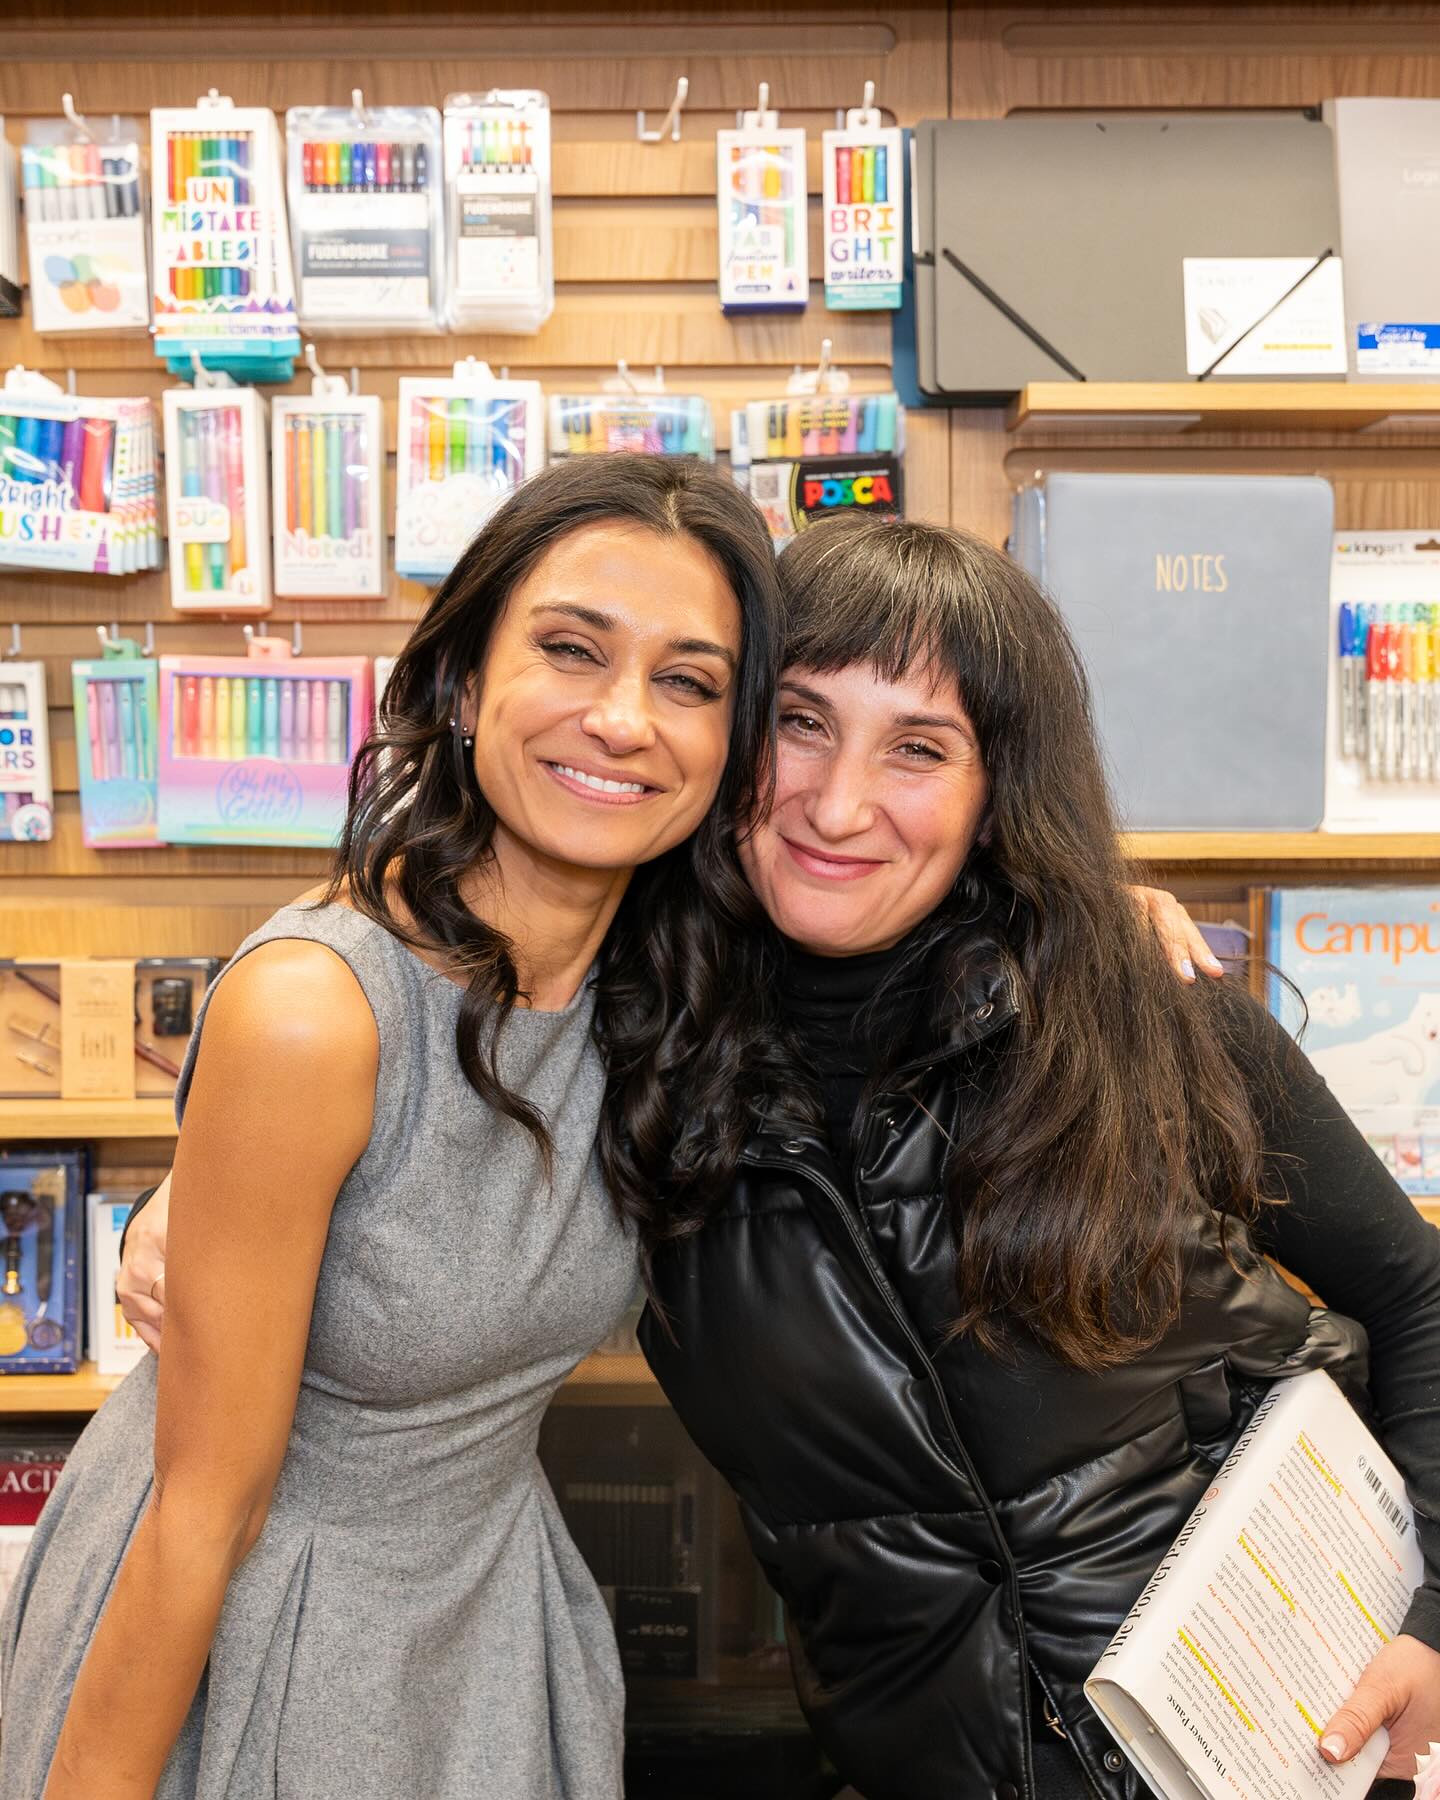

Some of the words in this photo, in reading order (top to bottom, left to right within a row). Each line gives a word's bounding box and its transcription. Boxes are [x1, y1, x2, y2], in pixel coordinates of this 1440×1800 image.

[193, 183, 227, 203] UN
[830, 207, 894, 232] BRI
[830, 237, 895, 262] GHT
[803, 476, 893, 508] POSCA
[282, 533, 373, 559] Noted!
[1155, 554, 1229, 593] NOTES
[1104, 1620, 1135, 1661] The
[1128, 1561, 1172, 1622] Power
[1166, 1503, 1209, 1562] Pause
[1165, 1691, 1189, 1726] Pause
[1187, 1722, 1212, 1758] Power
[1210, 1753, 1227, 1779] The
